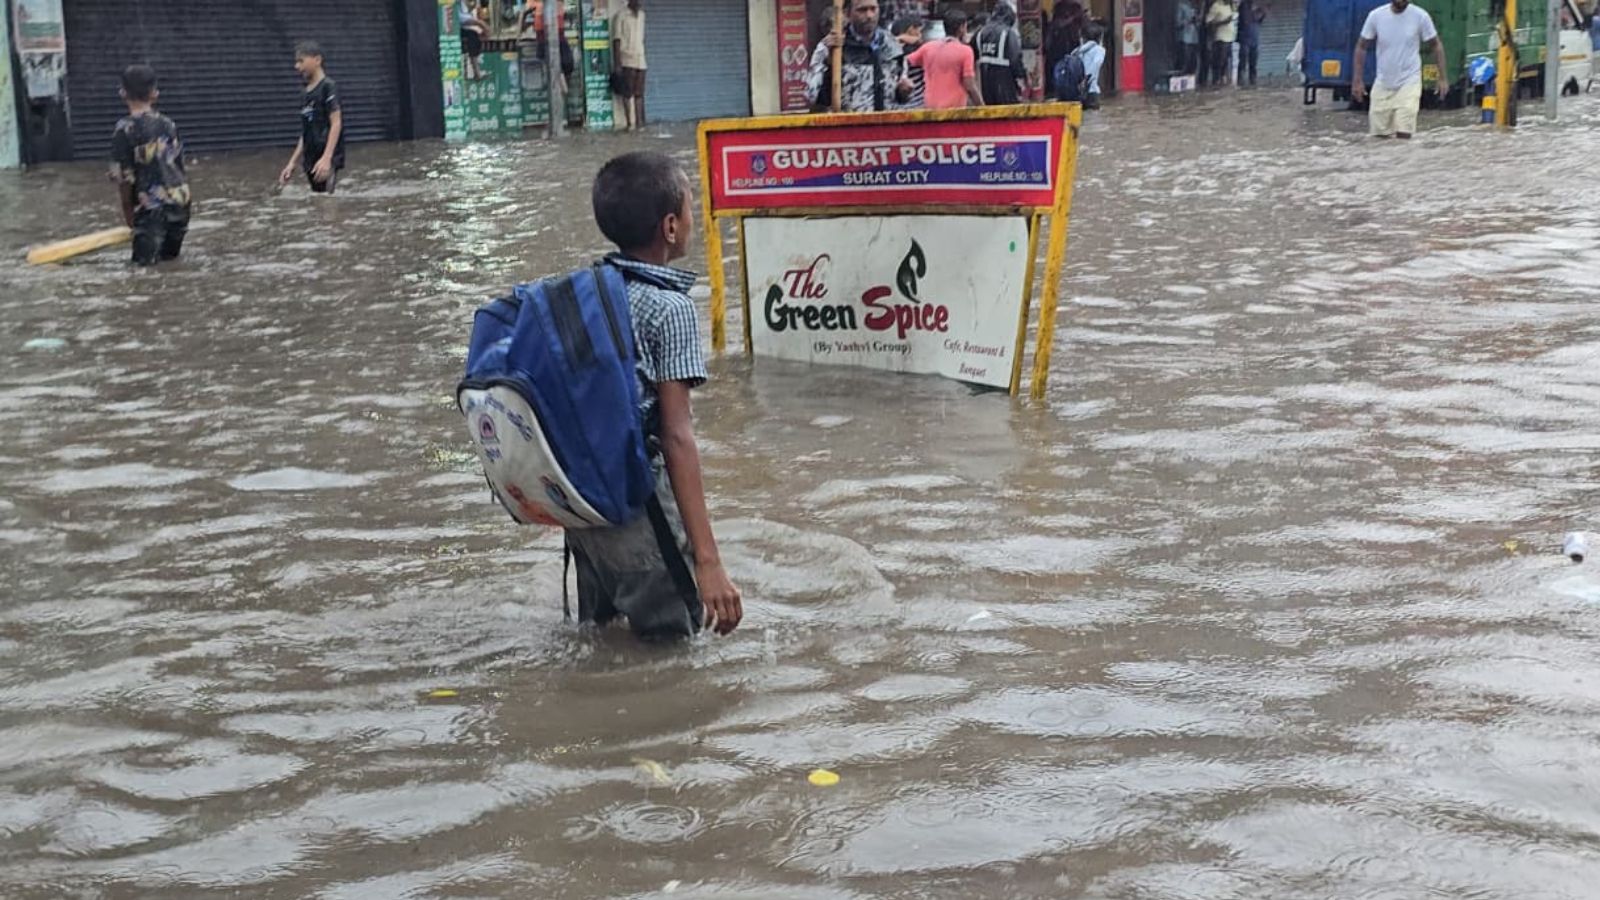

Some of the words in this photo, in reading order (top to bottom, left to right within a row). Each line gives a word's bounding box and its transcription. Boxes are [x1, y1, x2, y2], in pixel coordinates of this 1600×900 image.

[772, 146, 891, 169] GUJARAT
[900, 143, 997, 165] POLICE
[842, 170, 891, 185] SURAT
[895, 169, 930, 183] CITY
[783, 253, 831, 299] The
[764, 284, 858, 332] Green
[862, 286, 949, 340] Spice
[814, 341, 833, 355] (By
[872, 340, 913, 355] Group)
